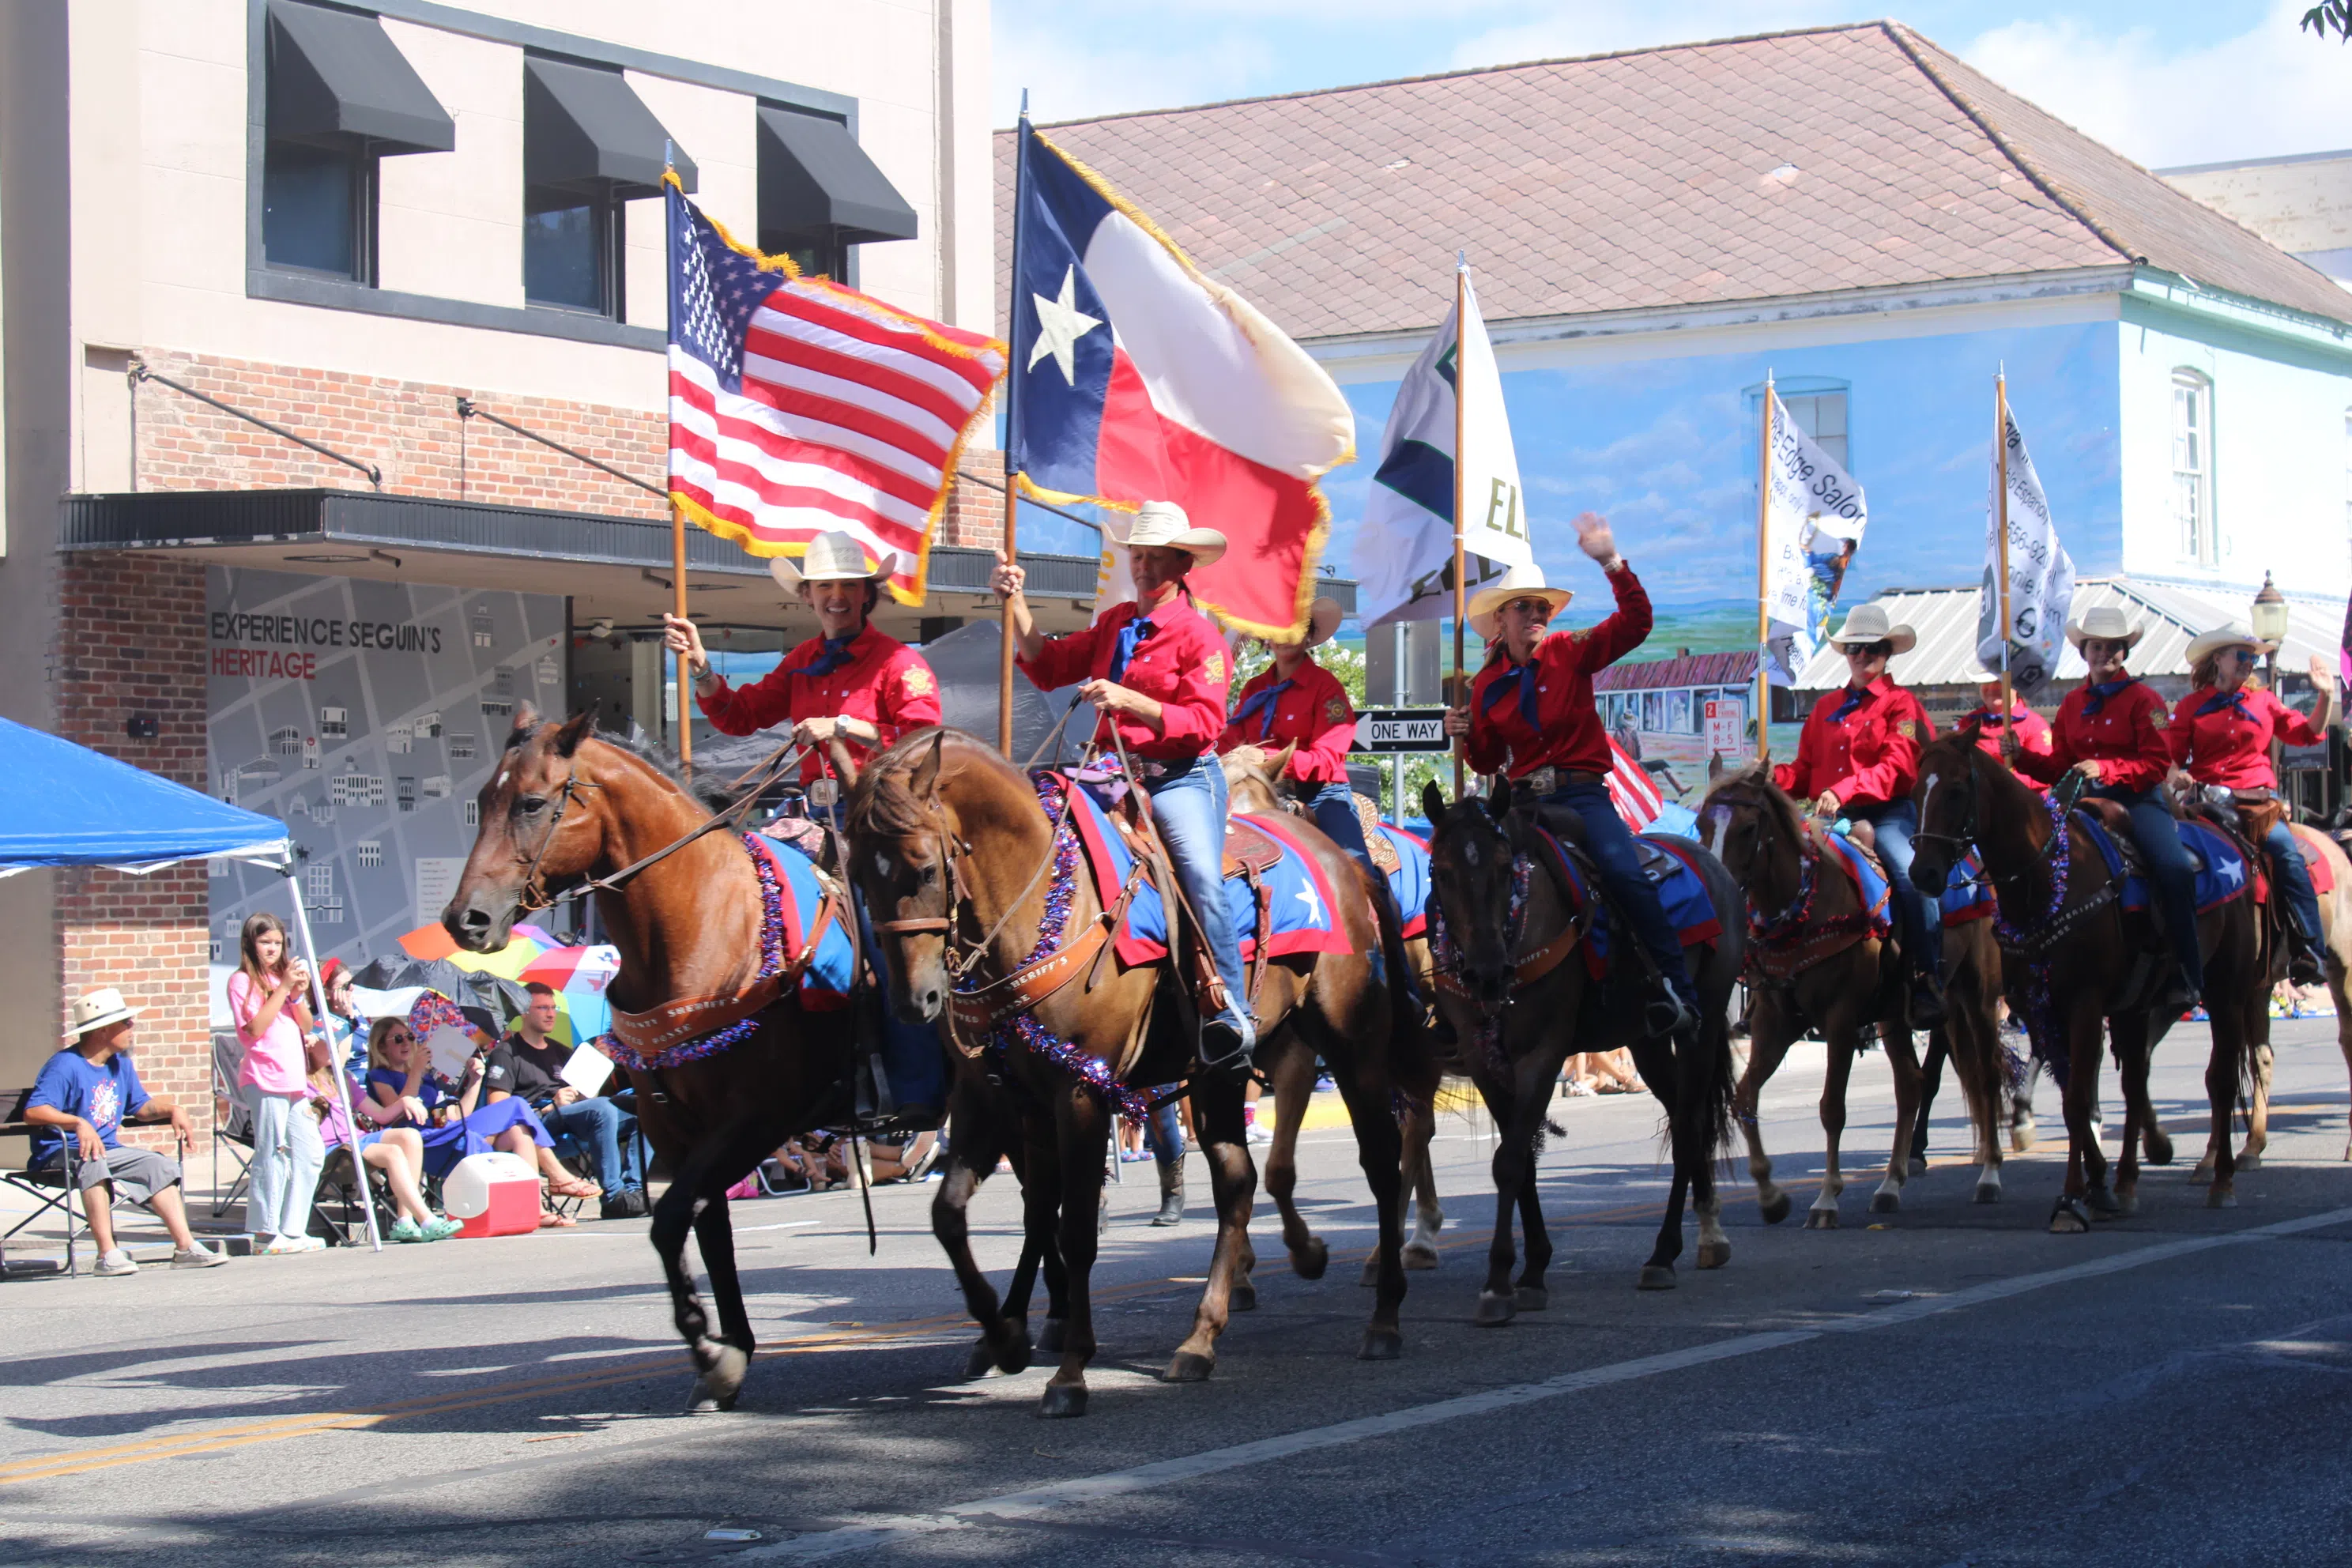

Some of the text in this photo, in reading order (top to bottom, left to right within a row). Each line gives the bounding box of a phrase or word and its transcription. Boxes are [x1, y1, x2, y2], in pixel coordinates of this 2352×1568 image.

[1777, 435, 1815, 481] Edge
[211, 612, 441, 654] EXPERIENCE SEGUIN'S
[211, 648, 316, 680] HERITAGE
[1371, 722, 1438, 740] ONE WAY
[1004, 955, 1069, 993] SHERIFF'S
[666, 996, 741, 1018] SHERIFF'S
[990, 993, 1031, 1020] POSSE
